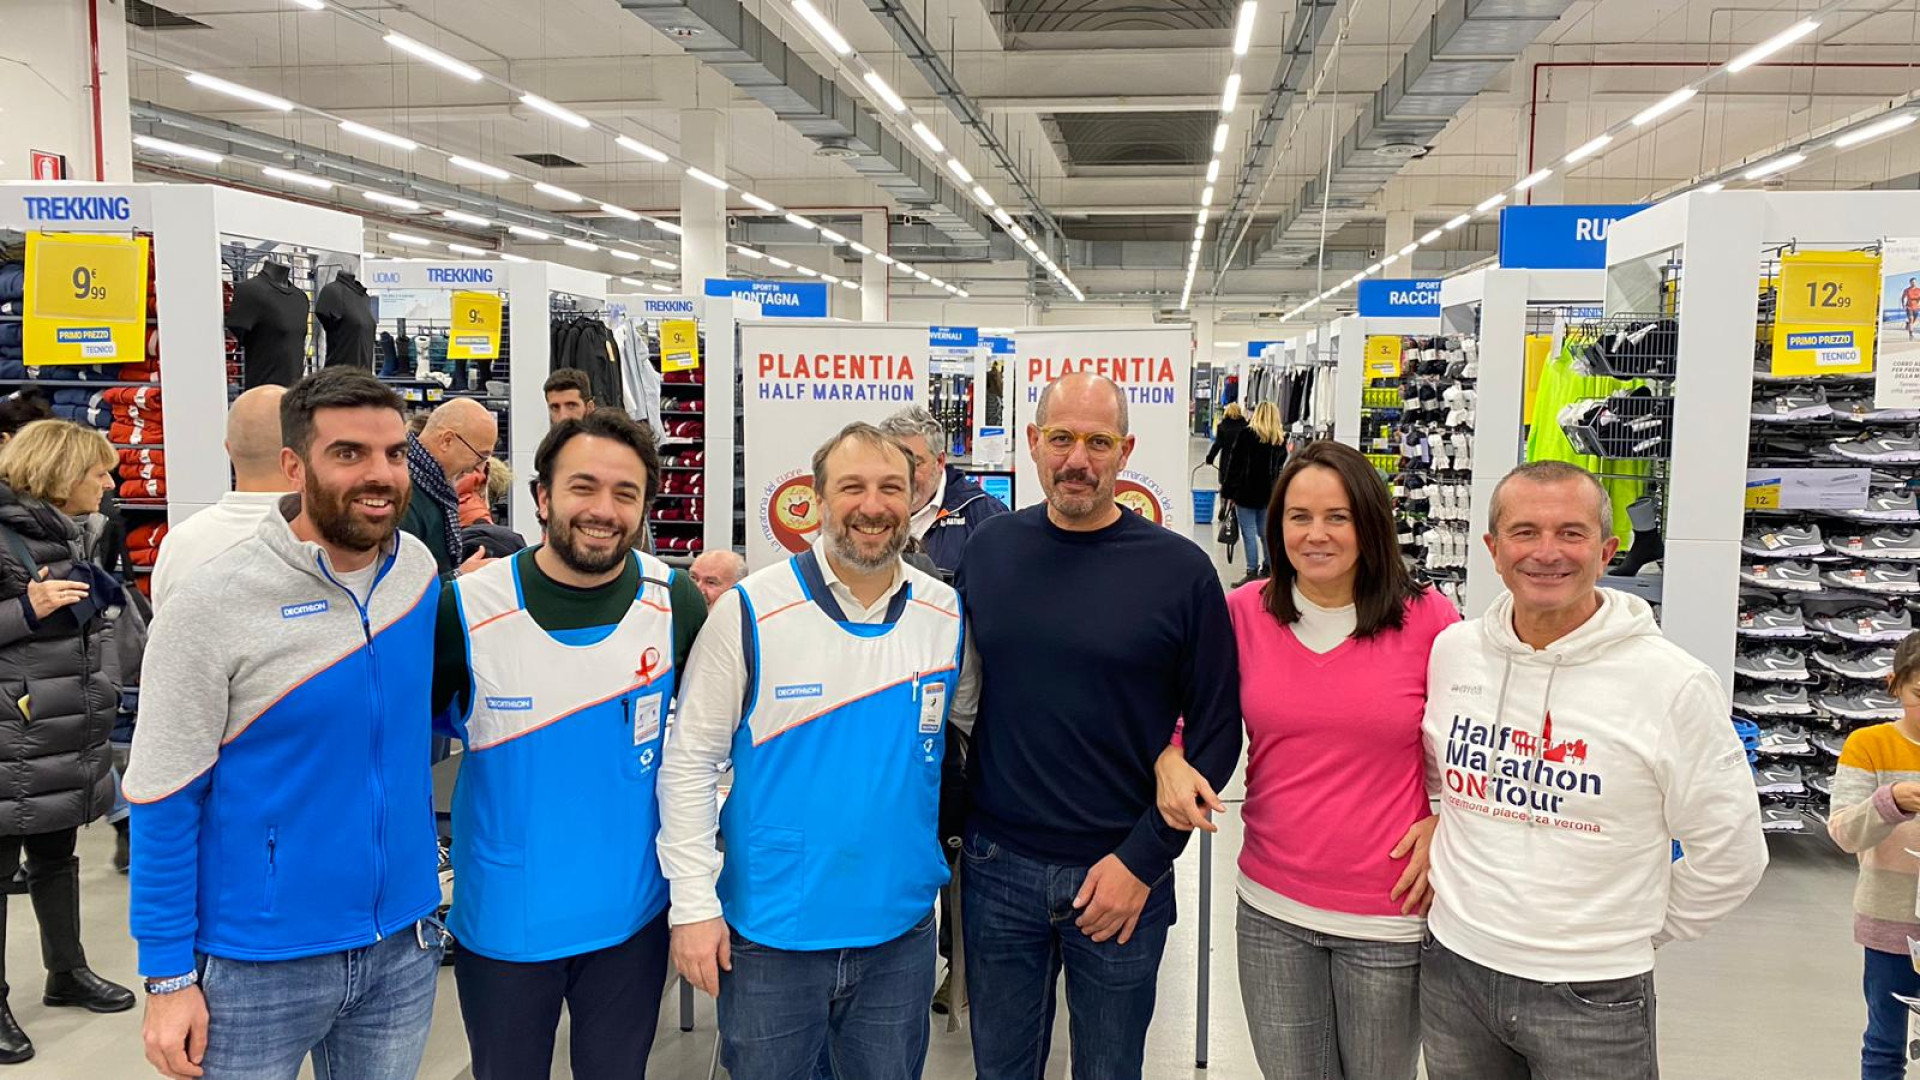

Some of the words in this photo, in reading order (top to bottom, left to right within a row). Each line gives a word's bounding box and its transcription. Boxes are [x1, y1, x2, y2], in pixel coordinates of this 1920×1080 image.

[23, 196, 130, 220] TREKKING
[1576, 218, 1616, 241] RU
[372, 272, 400, 283] UOMO
[427, 268, 493, 282] TREKKING
[731, 290, 800, 306] MONTAGNA
[644, 300, 693, 312] TREKKING
[1790, 336, 1817, 346] PRIMO
[1818, 335, 1850, 344] PREZZO
[86, 346, 113, 354] TECNICO
[1822, 351, 1856, 361] TECNICO
[758, 353, 914, 379] PLACENTIA
[759, 383, 806, 399] HALF
[812, 383, 914, 400] MARATHON
[283, 601, 326, 616] DECATHLON
[777, 687, 821, 697] DECATHLON
[1450, 714, 1512, 751] Half
[1445, 768, 1488, 799] ON
[1492, 777, 1565, 813] Tour
[1449, 795, 1490, 814] cremona
[1553, 817, 1602, 833] verona
